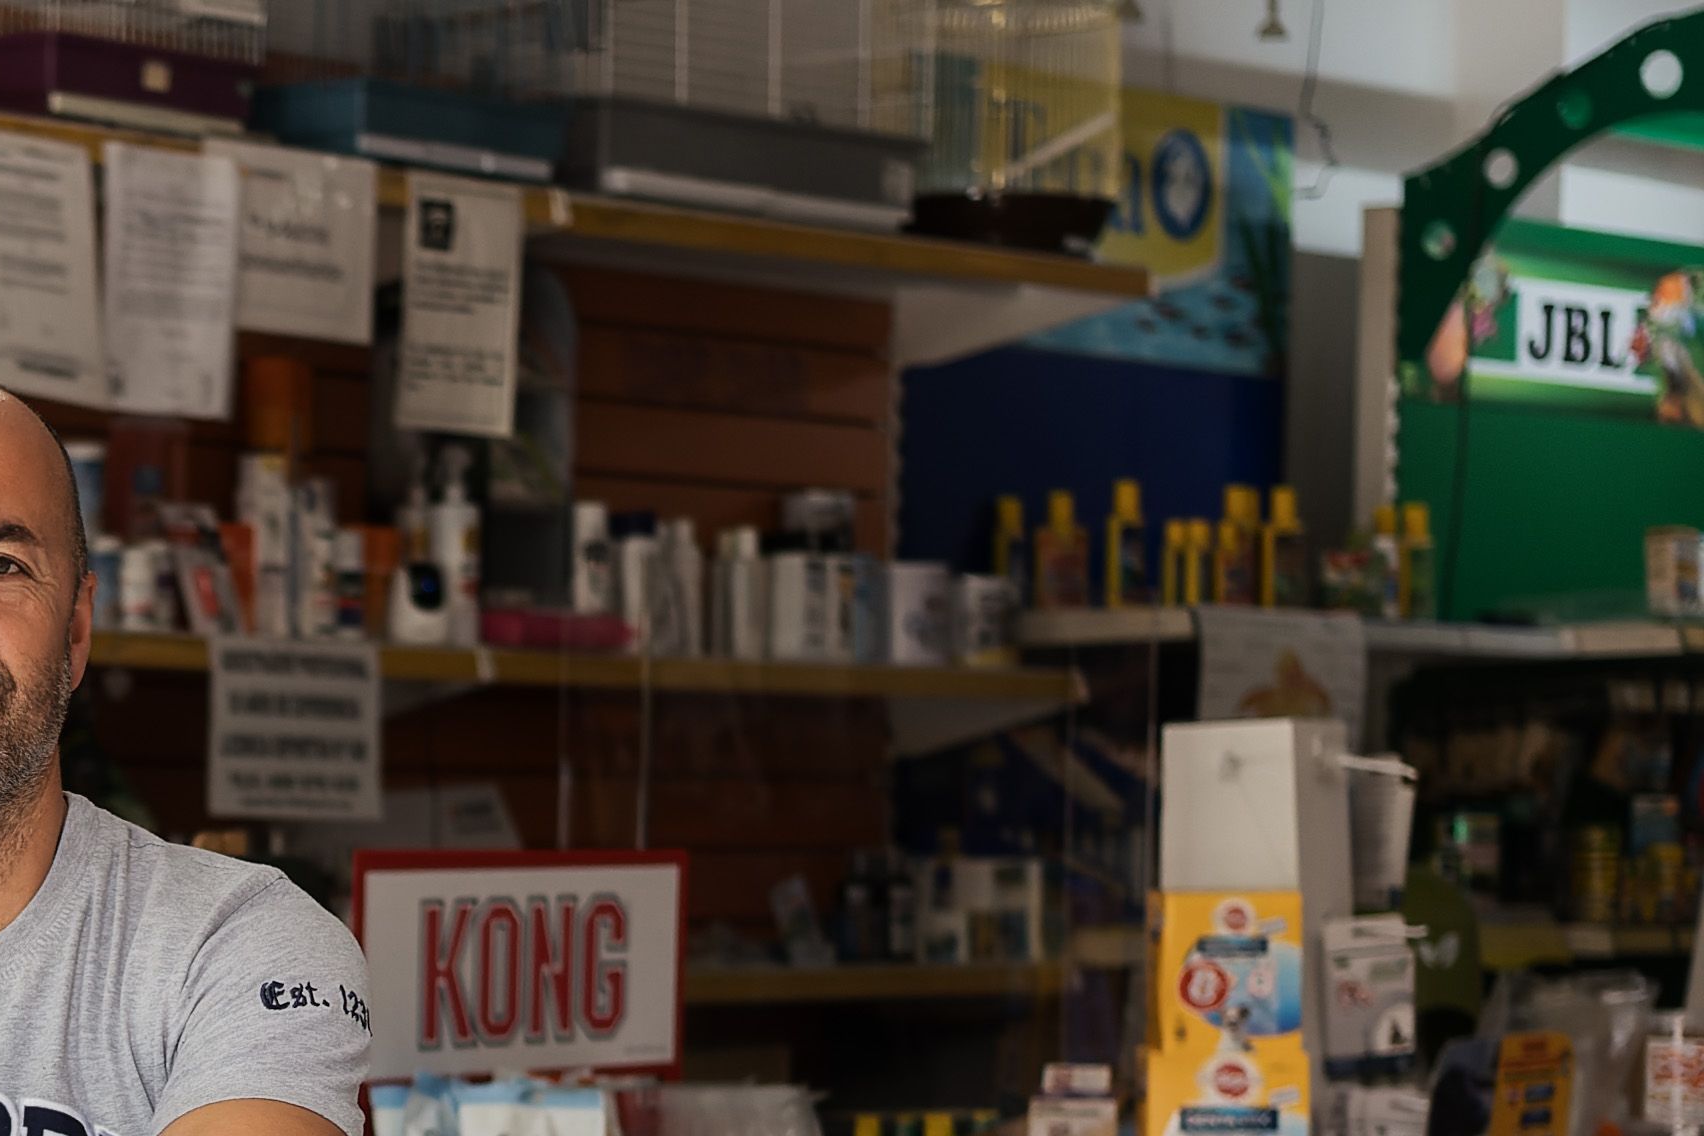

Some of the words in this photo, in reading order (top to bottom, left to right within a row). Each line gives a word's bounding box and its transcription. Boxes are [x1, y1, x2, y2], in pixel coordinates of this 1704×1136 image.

[1528, 299, 1630, 369] JBL
[260, 980, 330, 1010] Est.
[417, 892, 629, 1052] KONG
